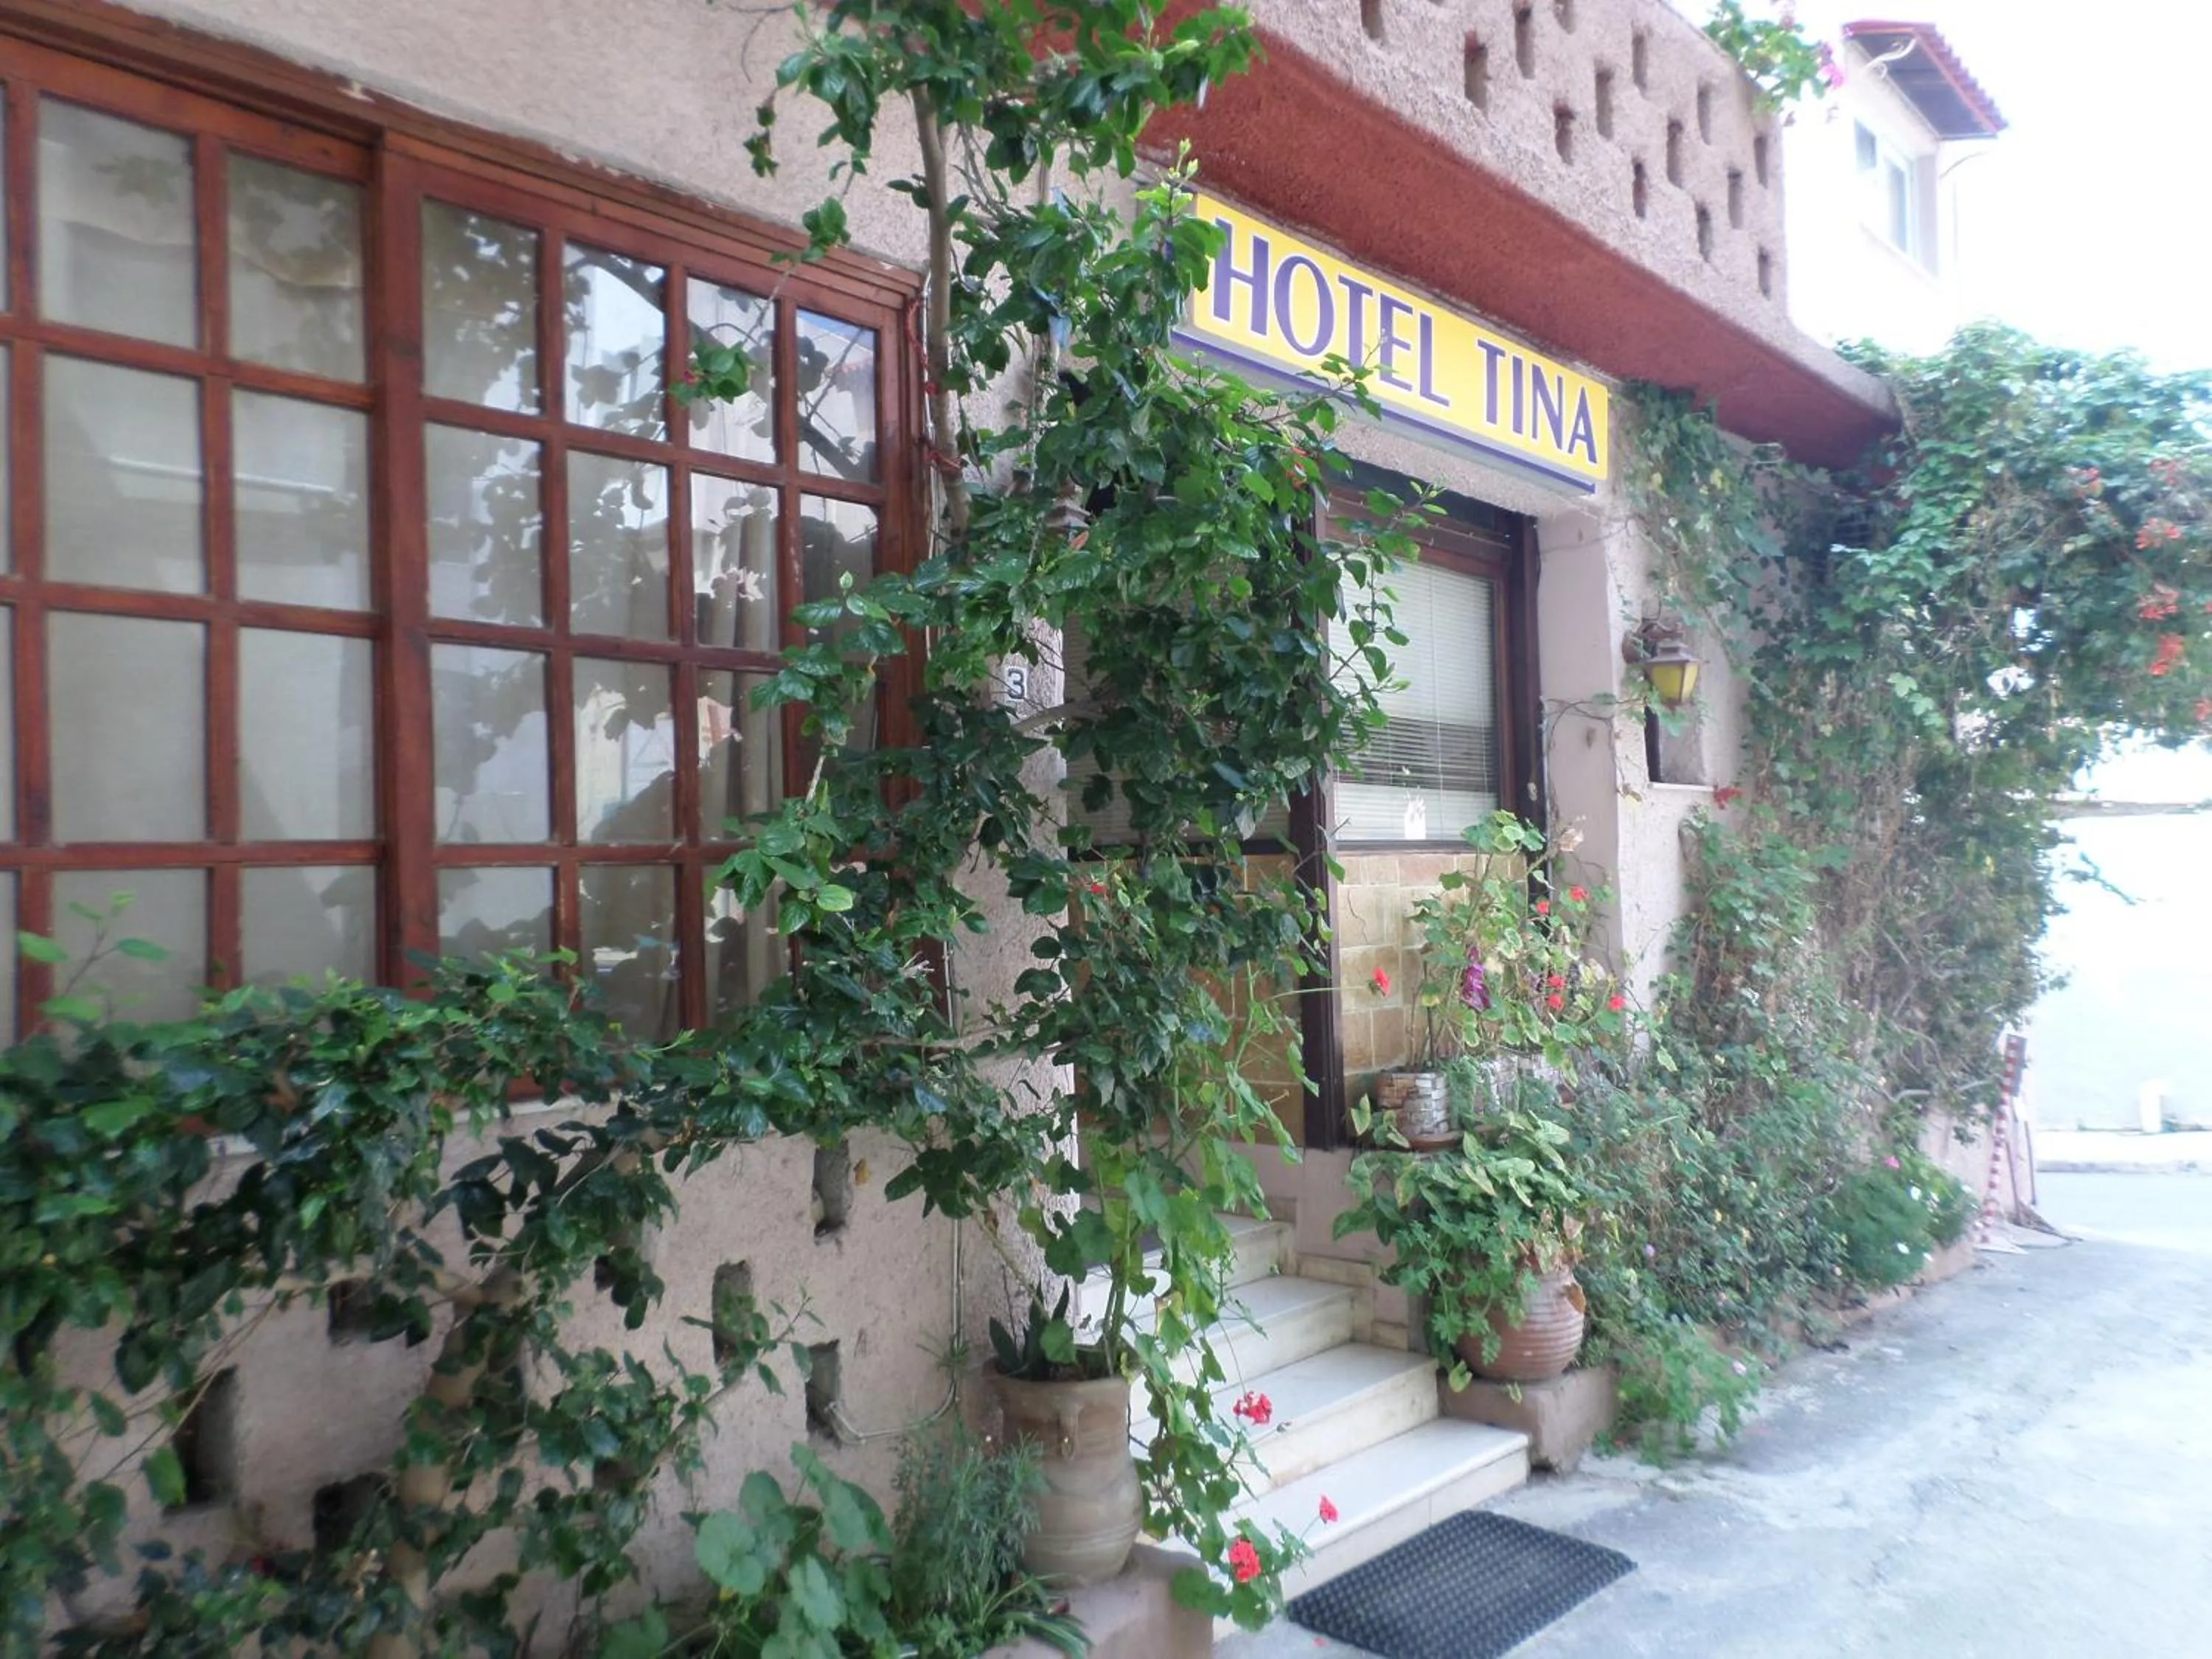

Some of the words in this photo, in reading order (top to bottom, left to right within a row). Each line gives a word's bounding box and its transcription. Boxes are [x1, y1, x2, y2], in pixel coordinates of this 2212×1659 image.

[1213, 218, 1450, 407] HOTEL
[1477, 338, 1598, 465] TINA
[1007, 668, 1025, 699] 3
